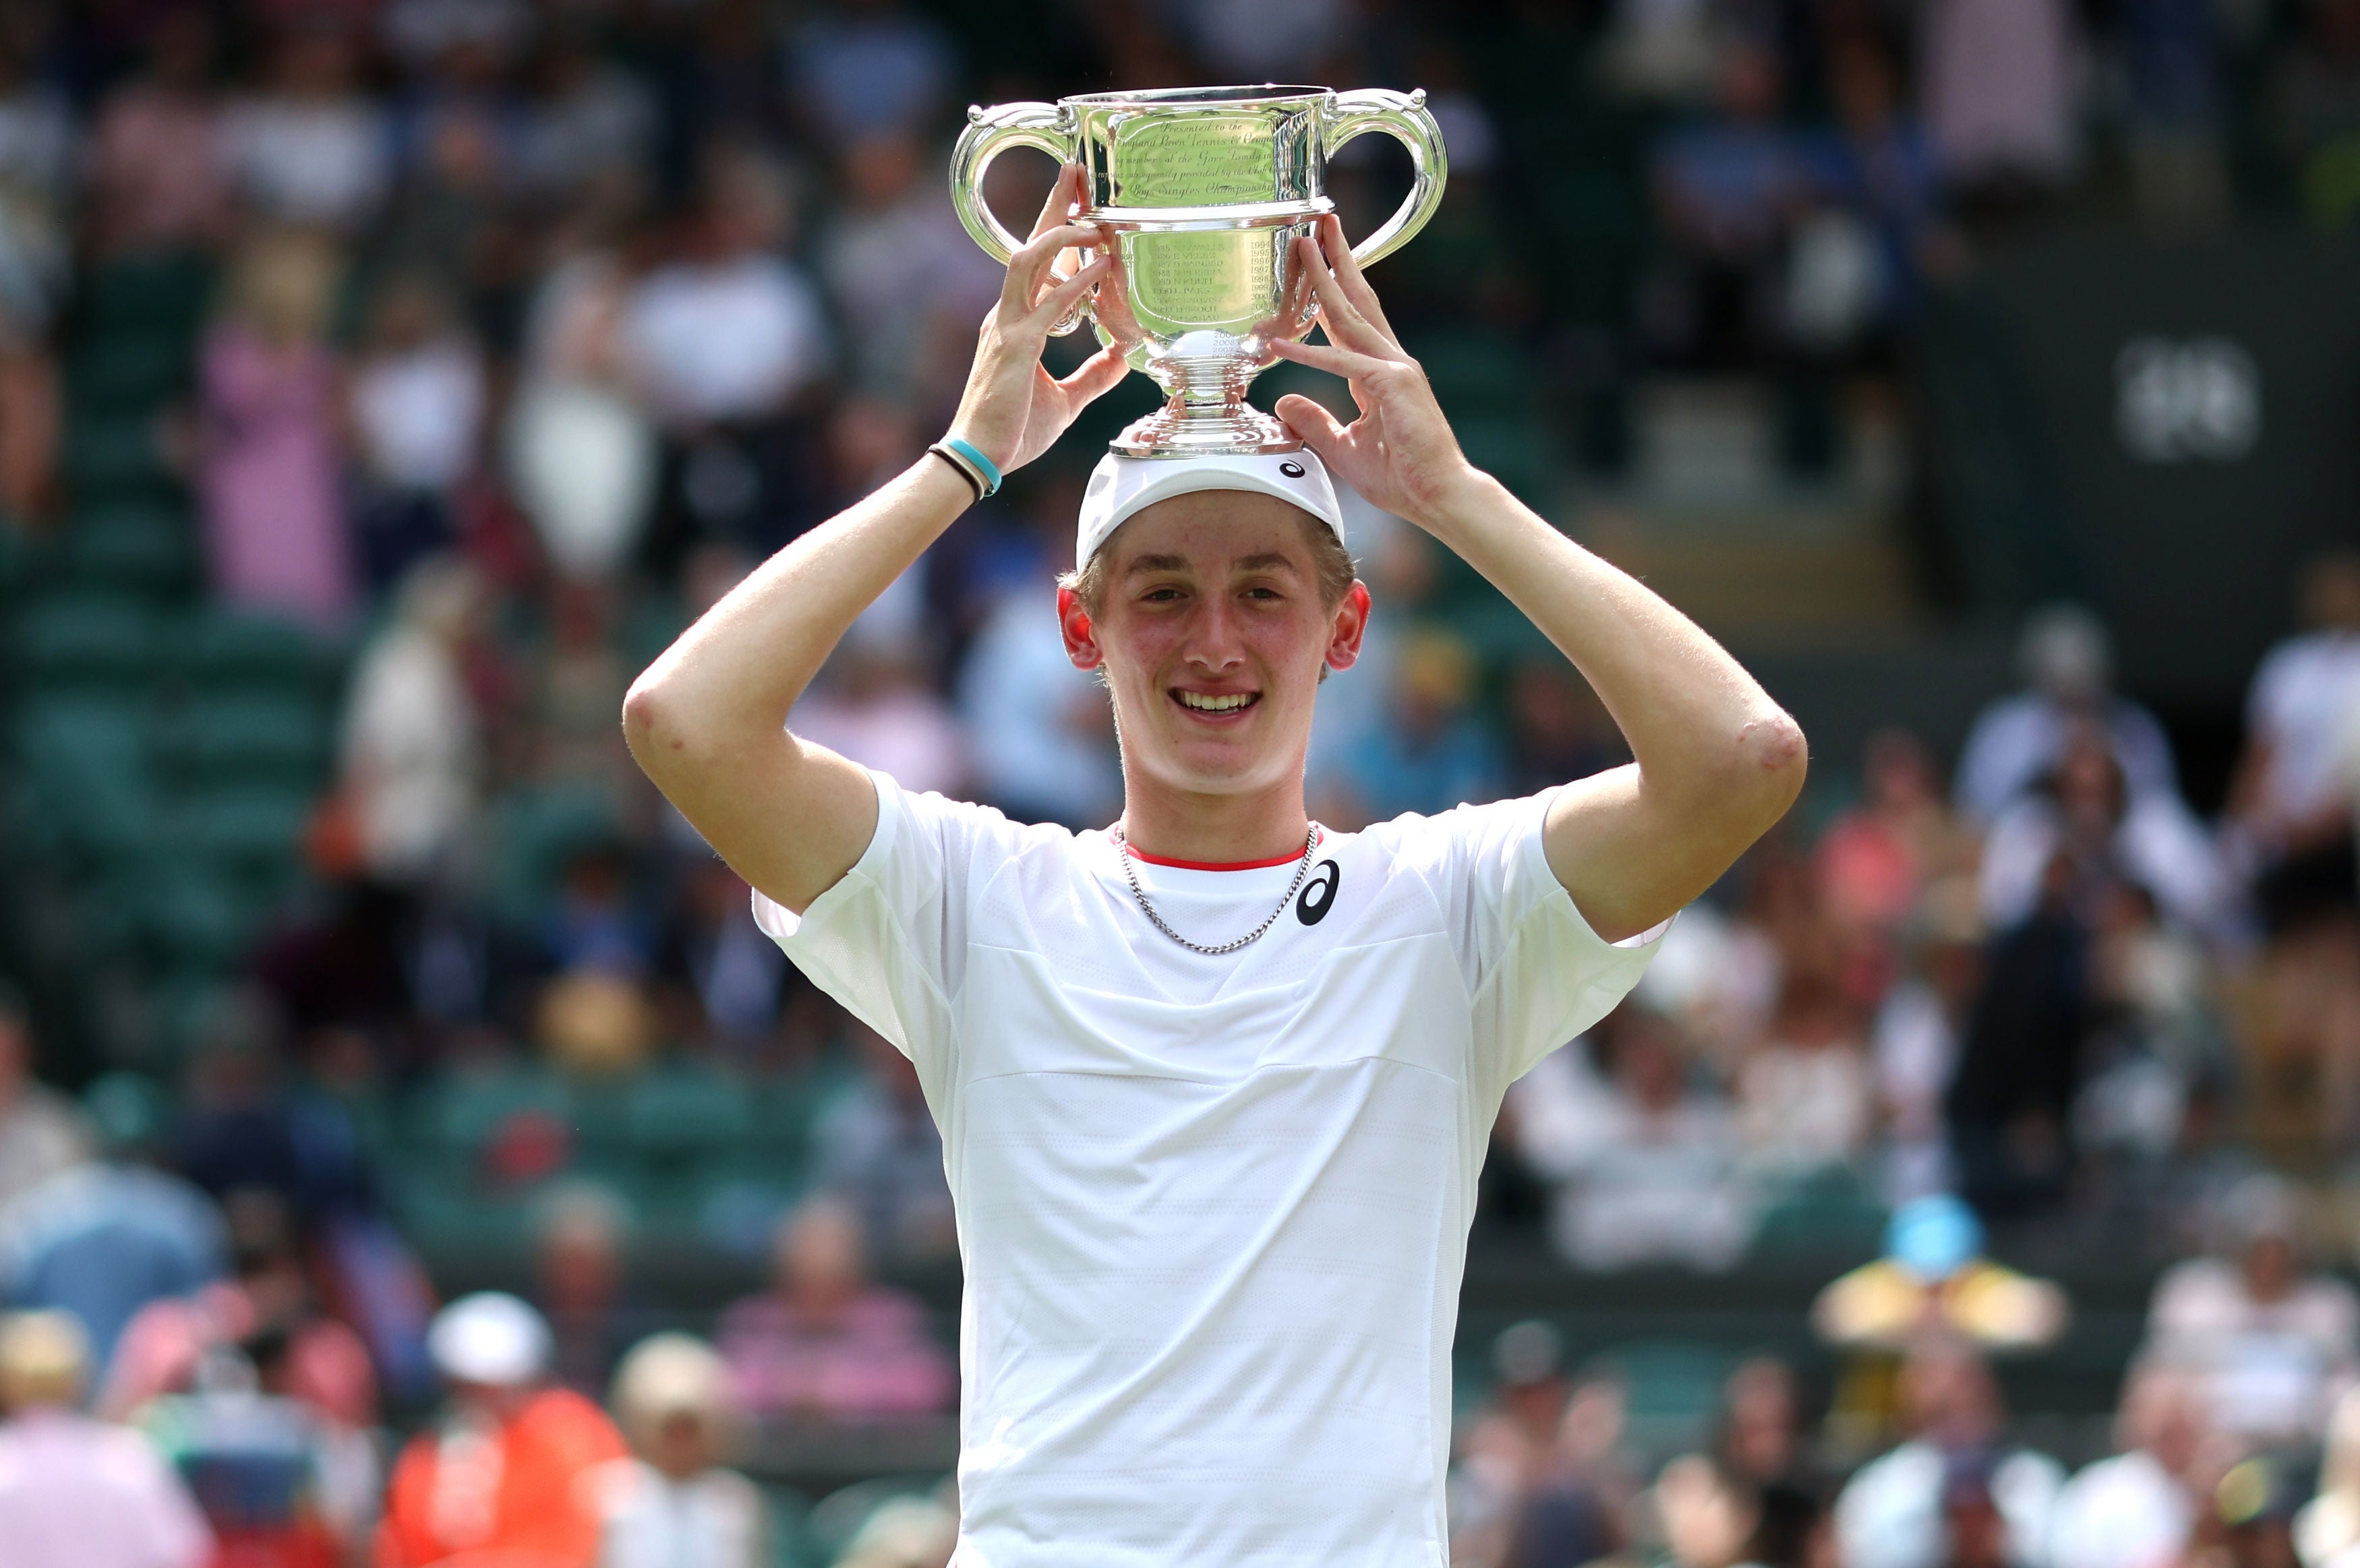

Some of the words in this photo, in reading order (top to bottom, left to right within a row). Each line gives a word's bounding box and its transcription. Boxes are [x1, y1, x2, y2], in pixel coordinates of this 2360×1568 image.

[1160, 120, 1212, 133] Presented
[1214, 123, 1225, 131] to
[1229, 119, 1243, 130] the
[1159, 135, 1185, 150] Lawn
[1187, 134, 1227, 147] Tennis
[1230, 135, 1241, 145] &
[1243, 131, 1274, 148] Croqu
[1164, 151, 1177, 162] of
[1178, 152, 1193, 162] the
[1227, 148, 1260, 162] Family
[1179, 167, 1219, 181] provided
[1221, 167, 1232, 179] by
[1233, 166, 1246, 177] the
[1129, 183, 1155, 200] Boys
[1158, 183, 1200, 200] Singles
[1251, 241, 1270, 249] 1994
[1251, 249, 1270, 258] 1995
[1251, 257, 1270, 265] 1996
[1251, 266, 1270, 274] 1997
[1251, 274, 1270, 283] 1998
[1251, 284, 1269, 292] 1999
[1251, 293, 1269, 301] 2000
